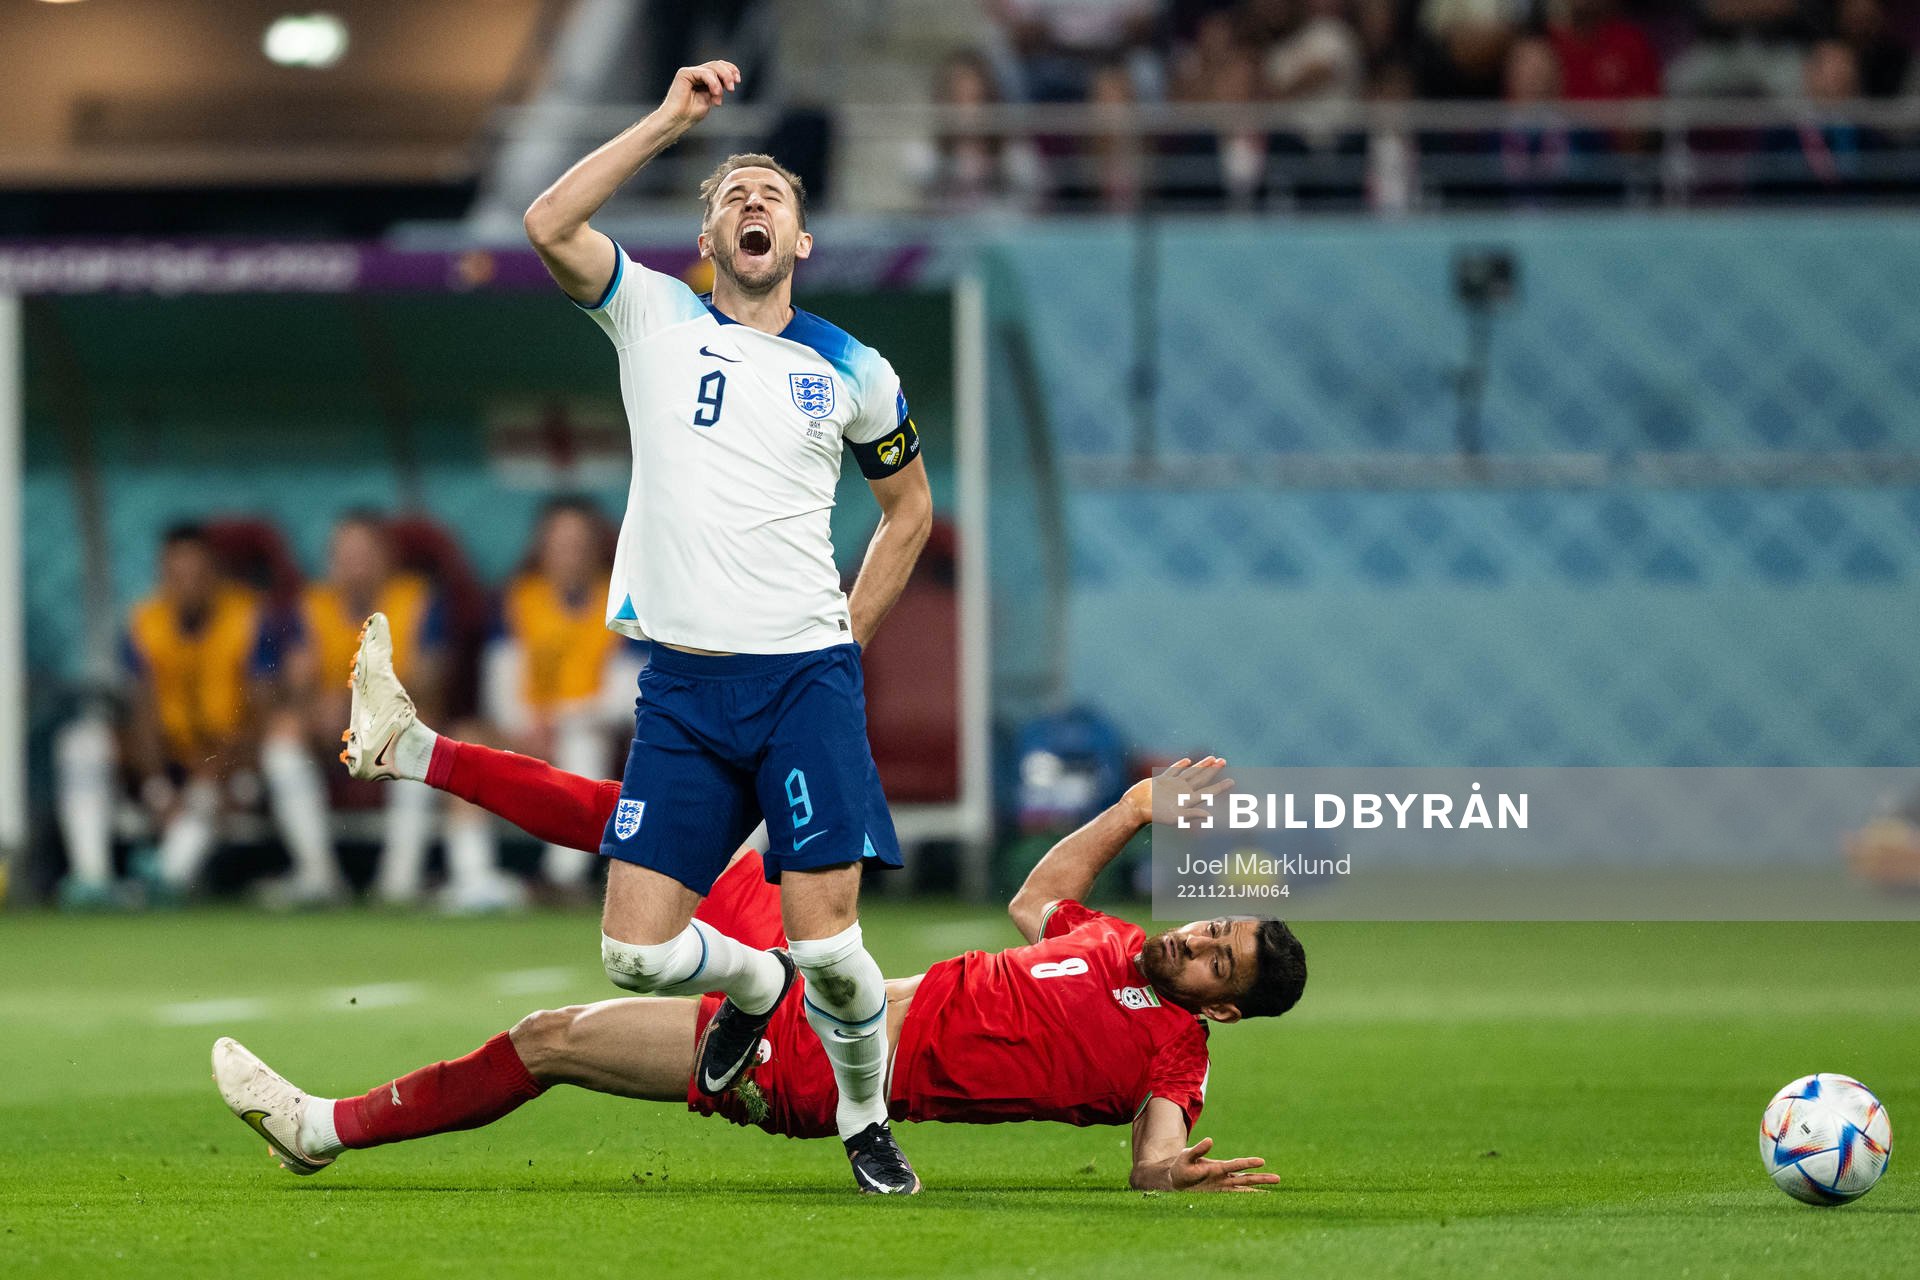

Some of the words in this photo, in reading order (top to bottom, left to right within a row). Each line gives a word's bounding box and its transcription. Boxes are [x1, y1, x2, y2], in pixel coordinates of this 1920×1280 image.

[693, 369, 726, 427] 9
[784, 767, 813, 829] 9
[1030, 957, 1089, 979] 8
